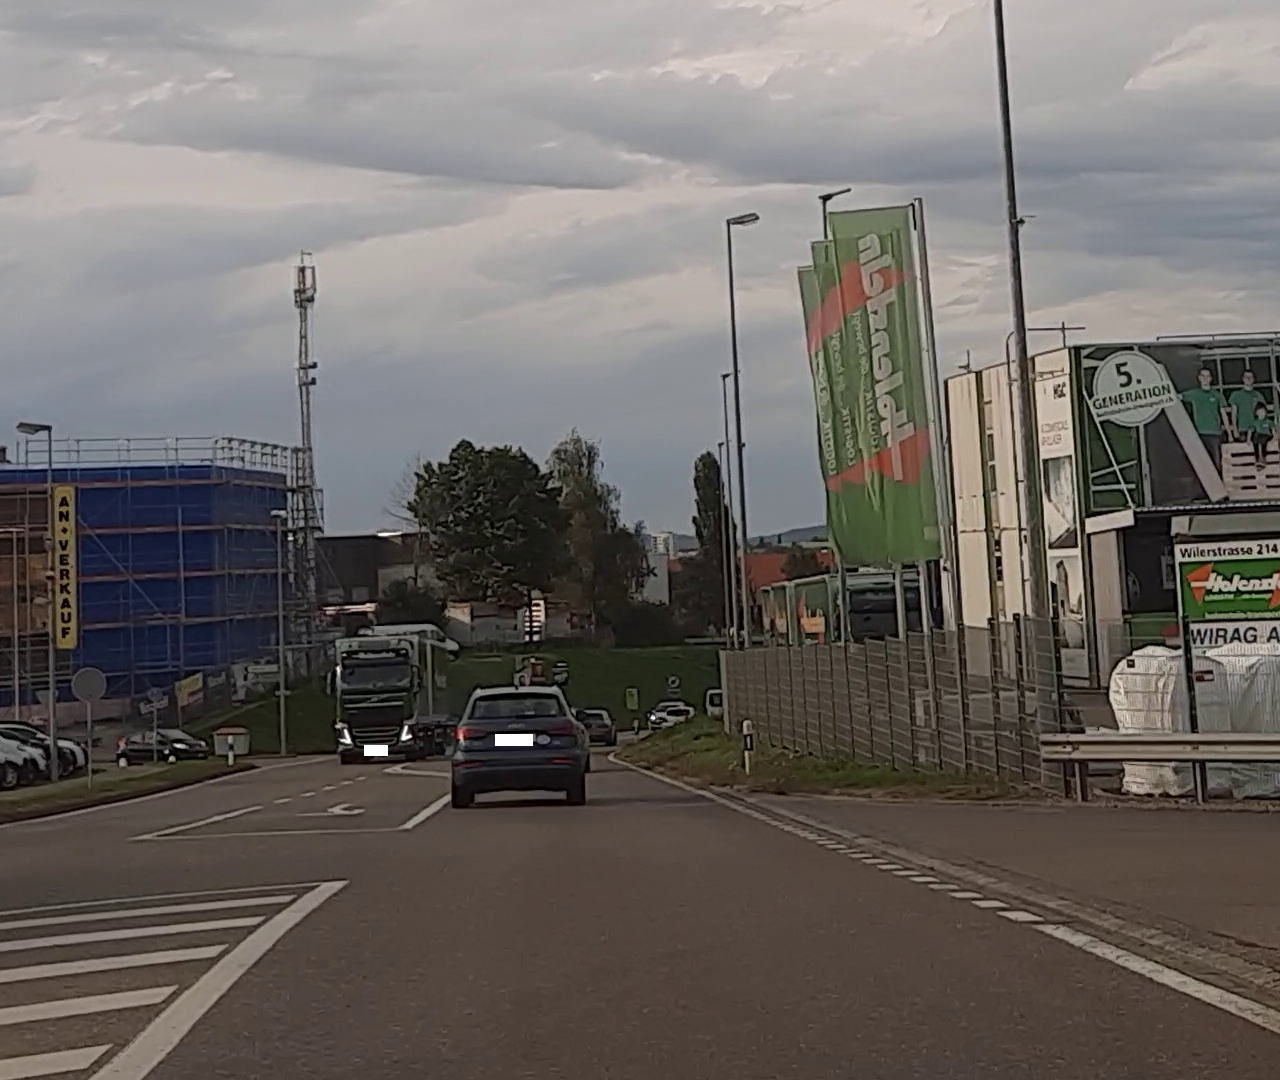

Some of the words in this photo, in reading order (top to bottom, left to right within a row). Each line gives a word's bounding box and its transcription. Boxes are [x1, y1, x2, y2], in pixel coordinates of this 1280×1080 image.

[1115, 361, 1142, 389] 5.
[1092, 384, 1172, 410] GENERATION
[1179, 546, 1254, 559] Wilerstrasse
[58, 540, 72, 639] VERKAUF
[1192, 626, 1258, 645] WIRAG
